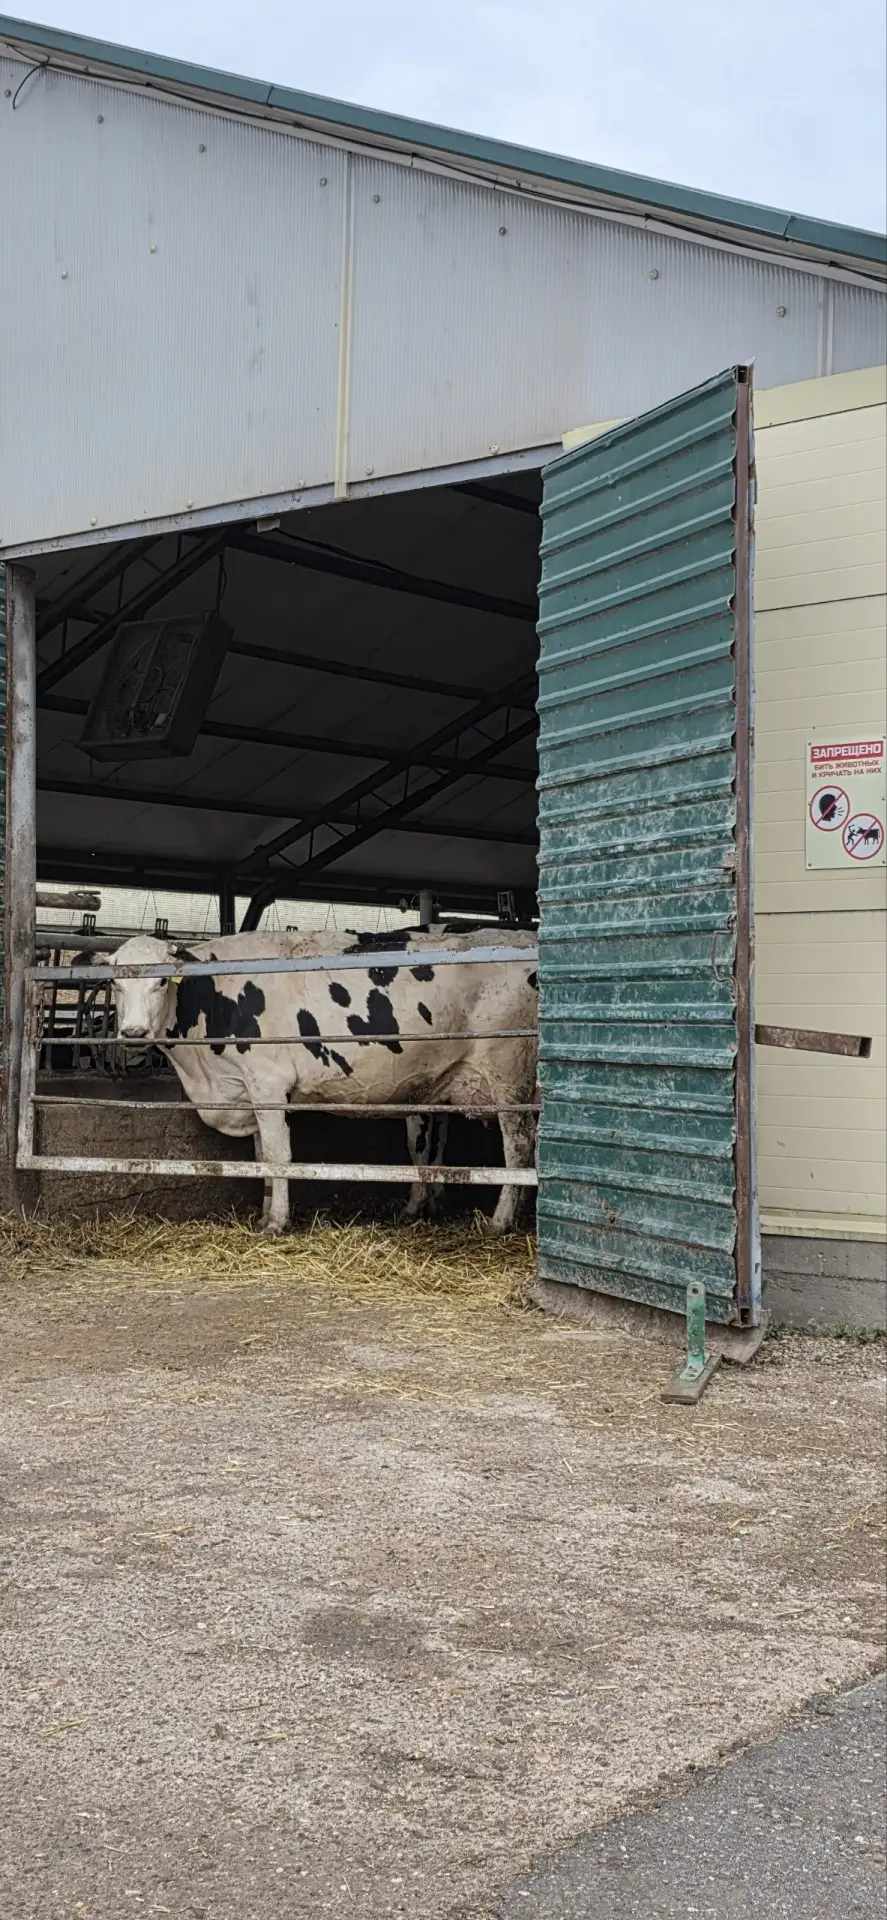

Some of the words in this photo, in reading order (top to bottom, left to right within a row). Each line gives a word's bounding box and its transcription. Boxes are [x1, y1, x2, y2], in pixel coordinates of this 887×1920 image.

[812, 743, 881, 759] ЗАПРЕЩЕНО
[835, 760, 879, 768] ЖИВОТНЫХ
[819, 769, 852, 778] КРИЧАТЬ
